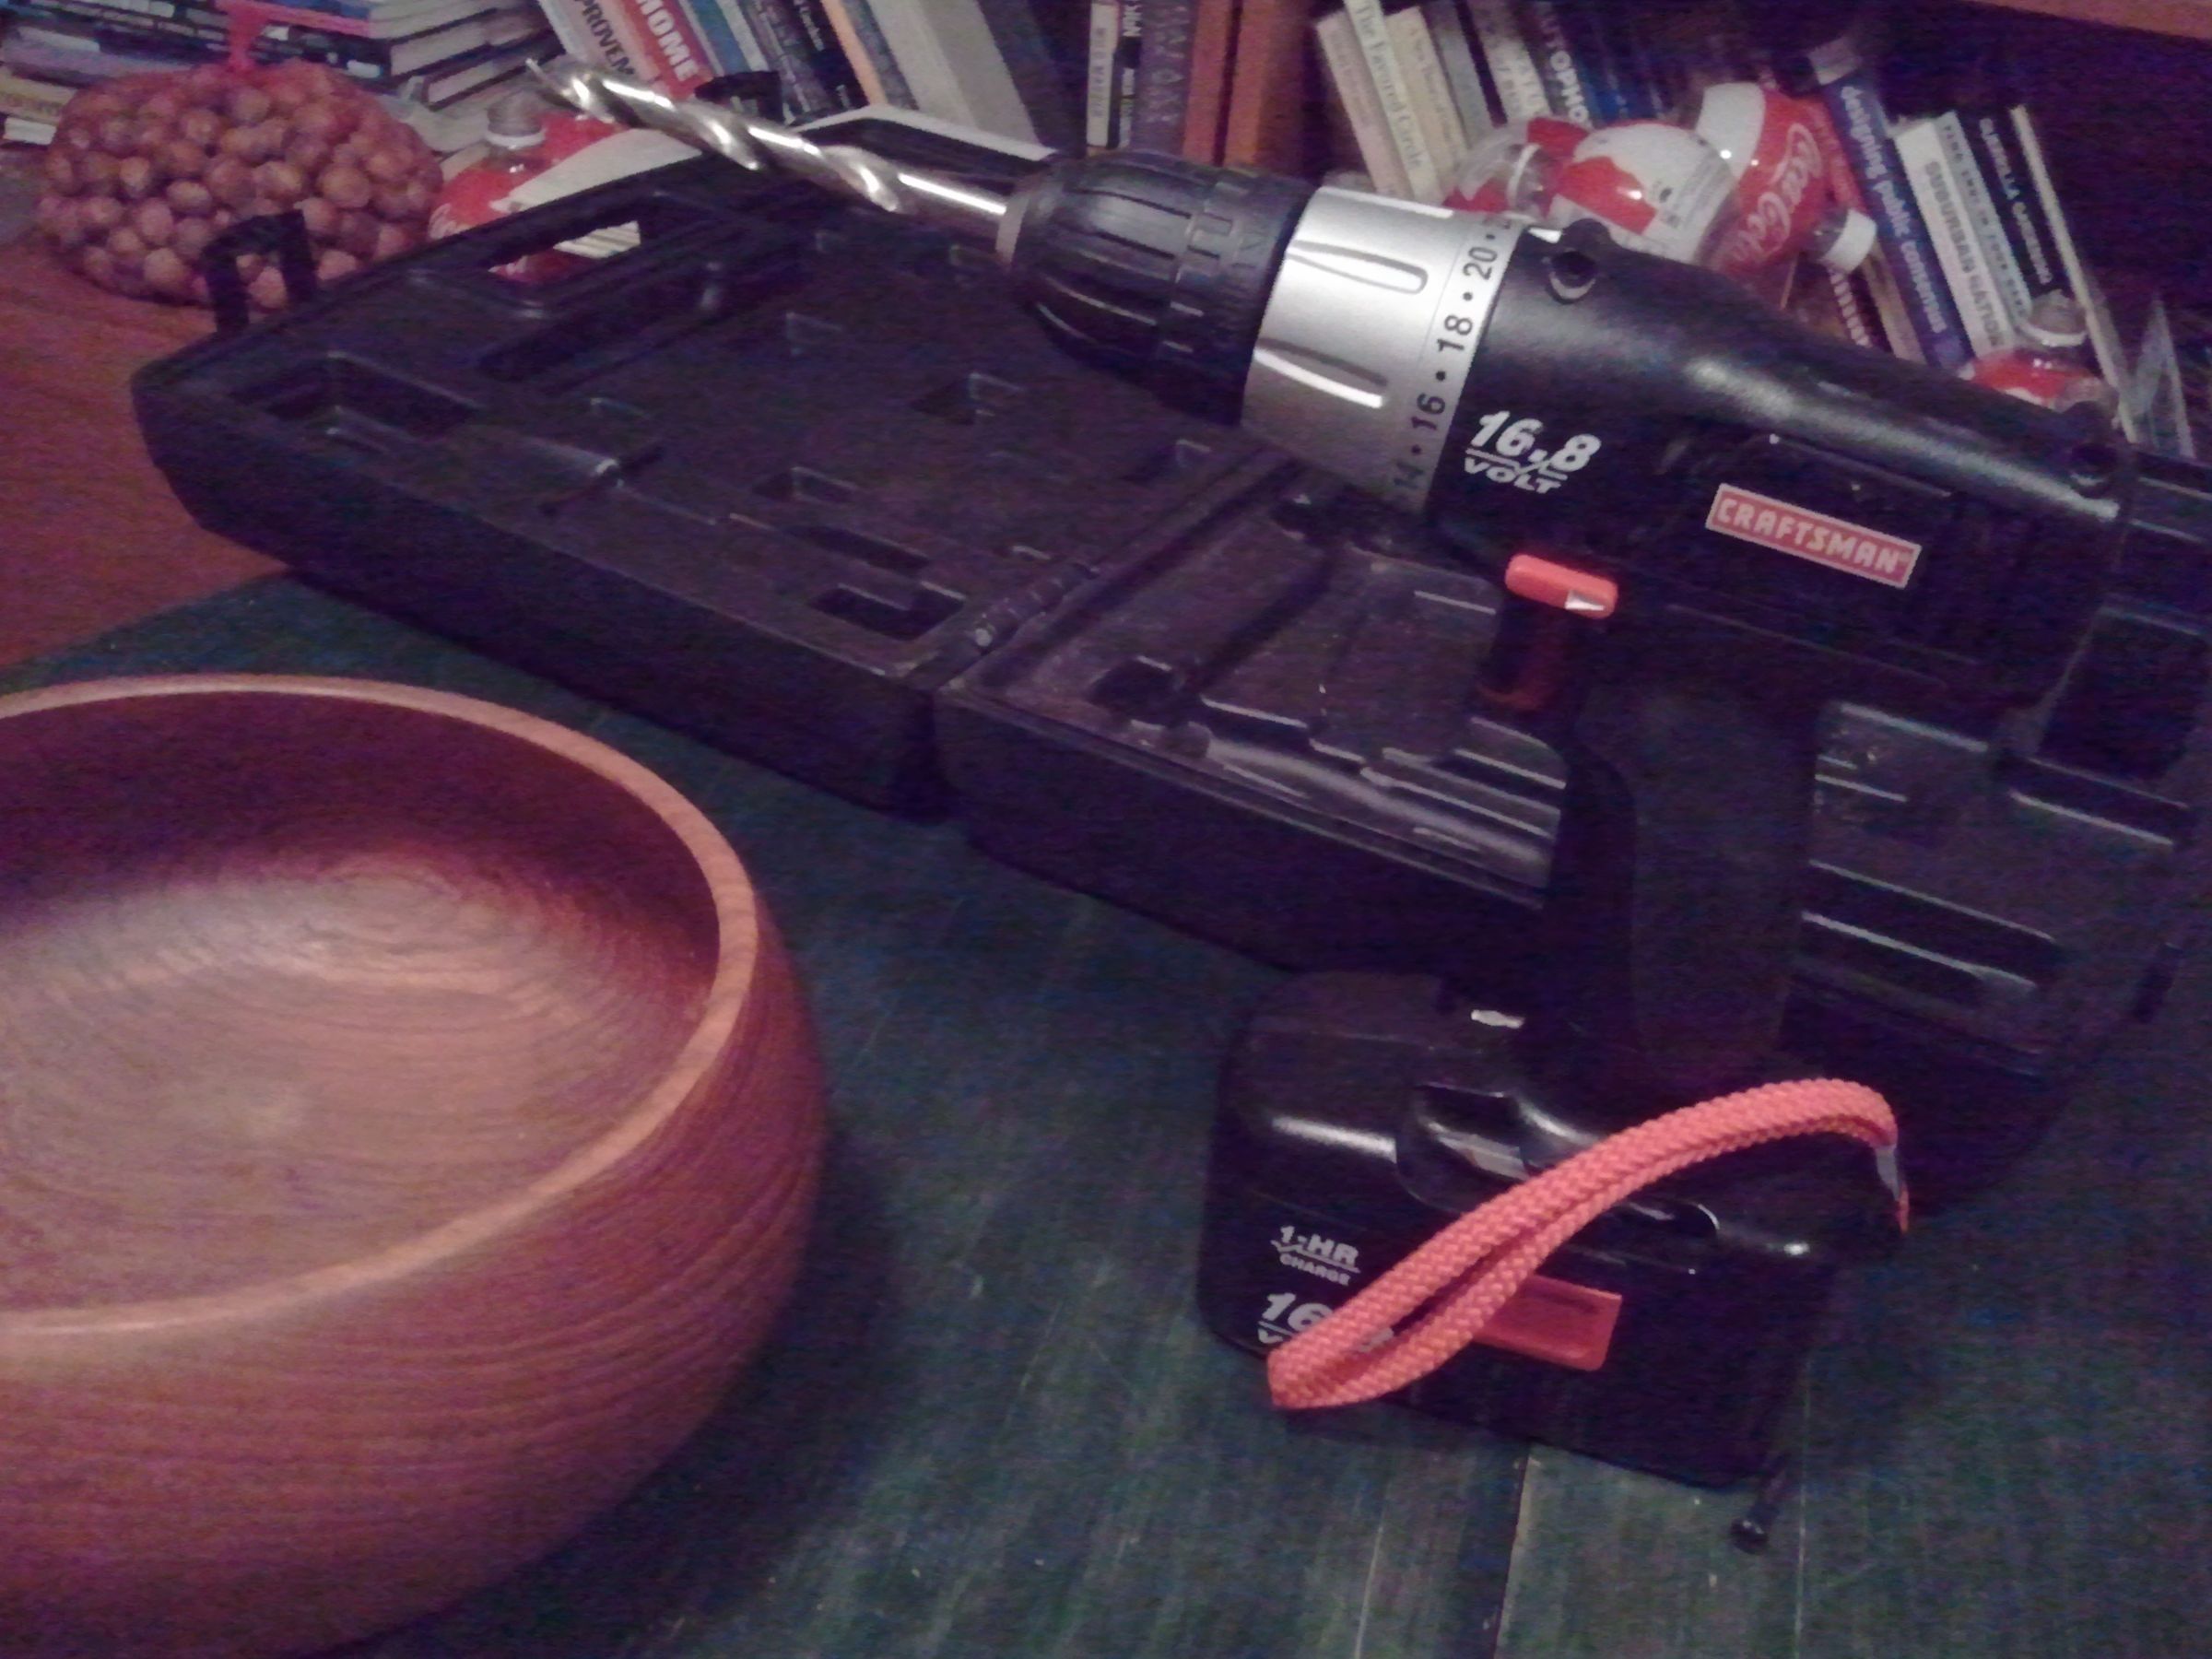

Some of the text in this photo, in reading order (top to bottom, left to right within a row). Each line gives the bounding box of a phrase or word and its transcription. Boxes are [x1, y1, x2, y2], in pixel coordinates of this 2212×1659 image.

[635, 0, 700, 81] HOME
[1872, 180, 1911, 238] public
[1462, 246, 1499, 281] 20
[1924, 159, 1976, 274] SUBURBAN
[1969, 275, 2006, 347] NATION
[1437, 313, 1474, 353] 18
[1410, 393, 1446, 431] 16
[1470, 410, 1602, 473] 16.8
[1464, 456, 1562, 494] VOLT
[1716, 498, 1900, 573] CRAFTSMAN
[1279, 1225, 1359, 1267] 1-HR
